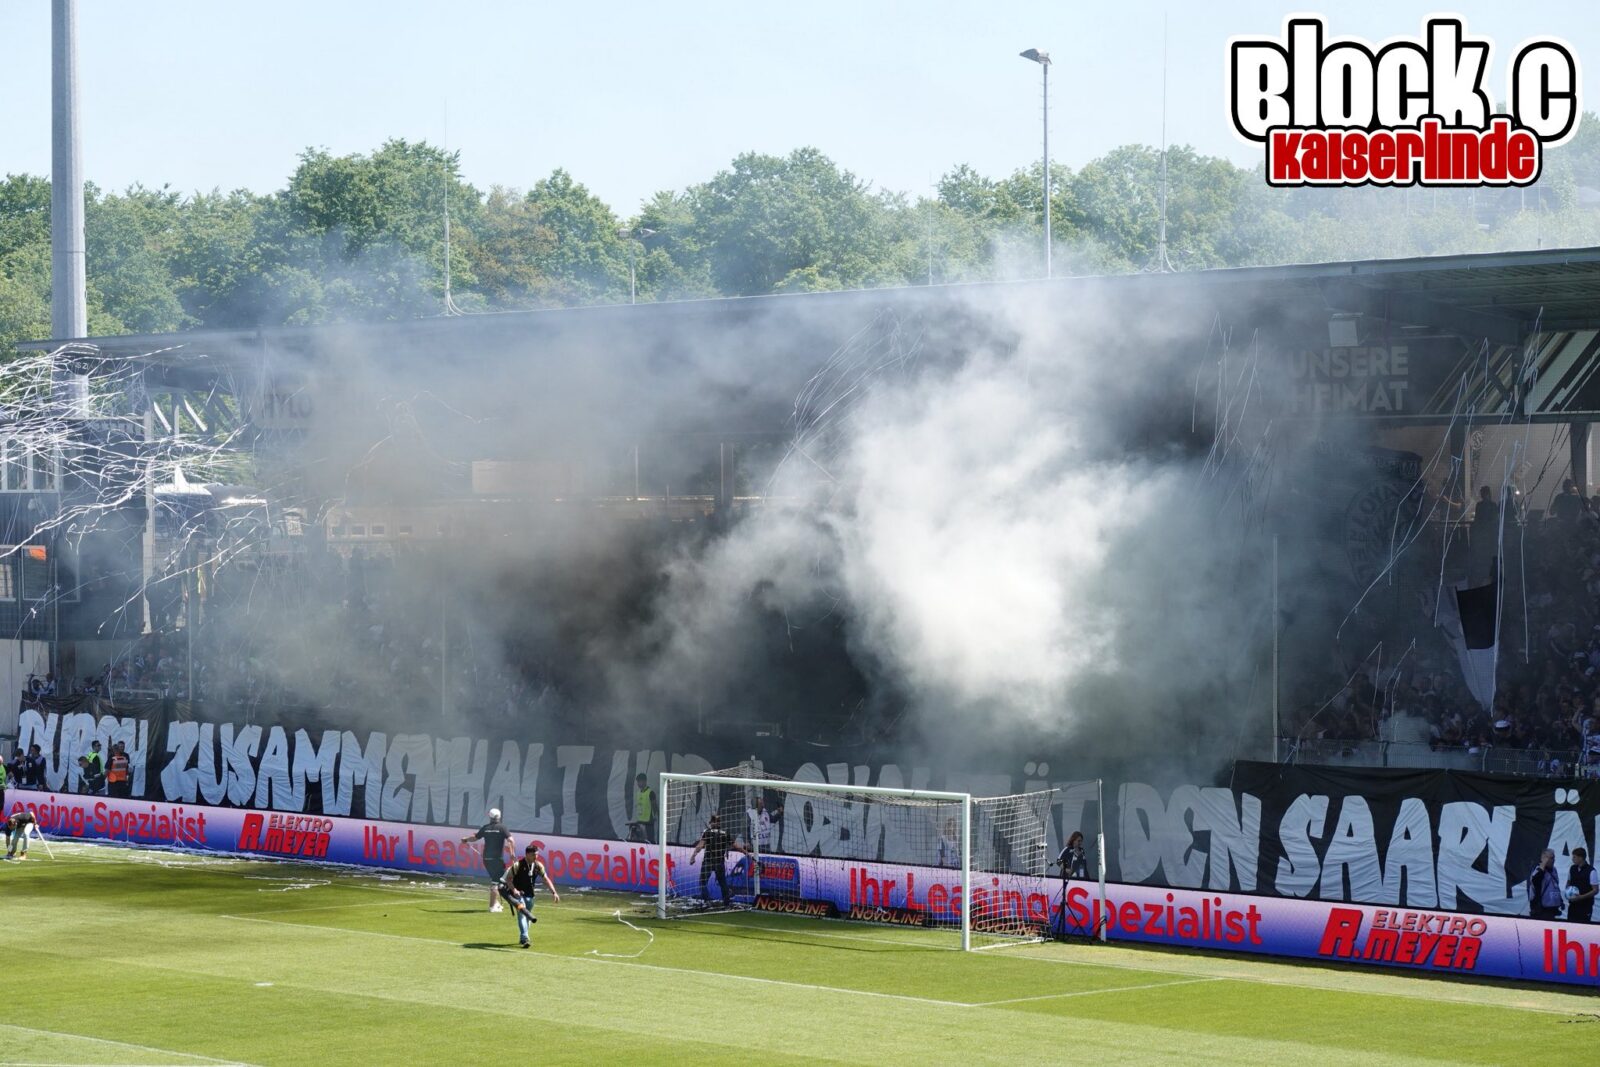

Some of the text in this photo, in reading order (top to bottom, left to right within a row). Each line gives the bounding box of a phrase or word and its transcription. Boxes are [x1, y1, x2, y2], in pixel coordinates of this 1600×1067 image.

[1288, 346, 1408, 378] UNSERE
[161, 721, 595, 836] ZUSAMMENHALT
[1118, 782, 1262, 892] DEN
[269, 814, 333, 832] ELEKTRO
[363, 825, 400, 861] Ihr
[850, 867, 896, 907] Ihr
[755, 896, 829, 916] NOVOLINE
[850, 904, 925, 926] NOVOLINE
[1372, 909, 1487, 937] ELEKTRO
